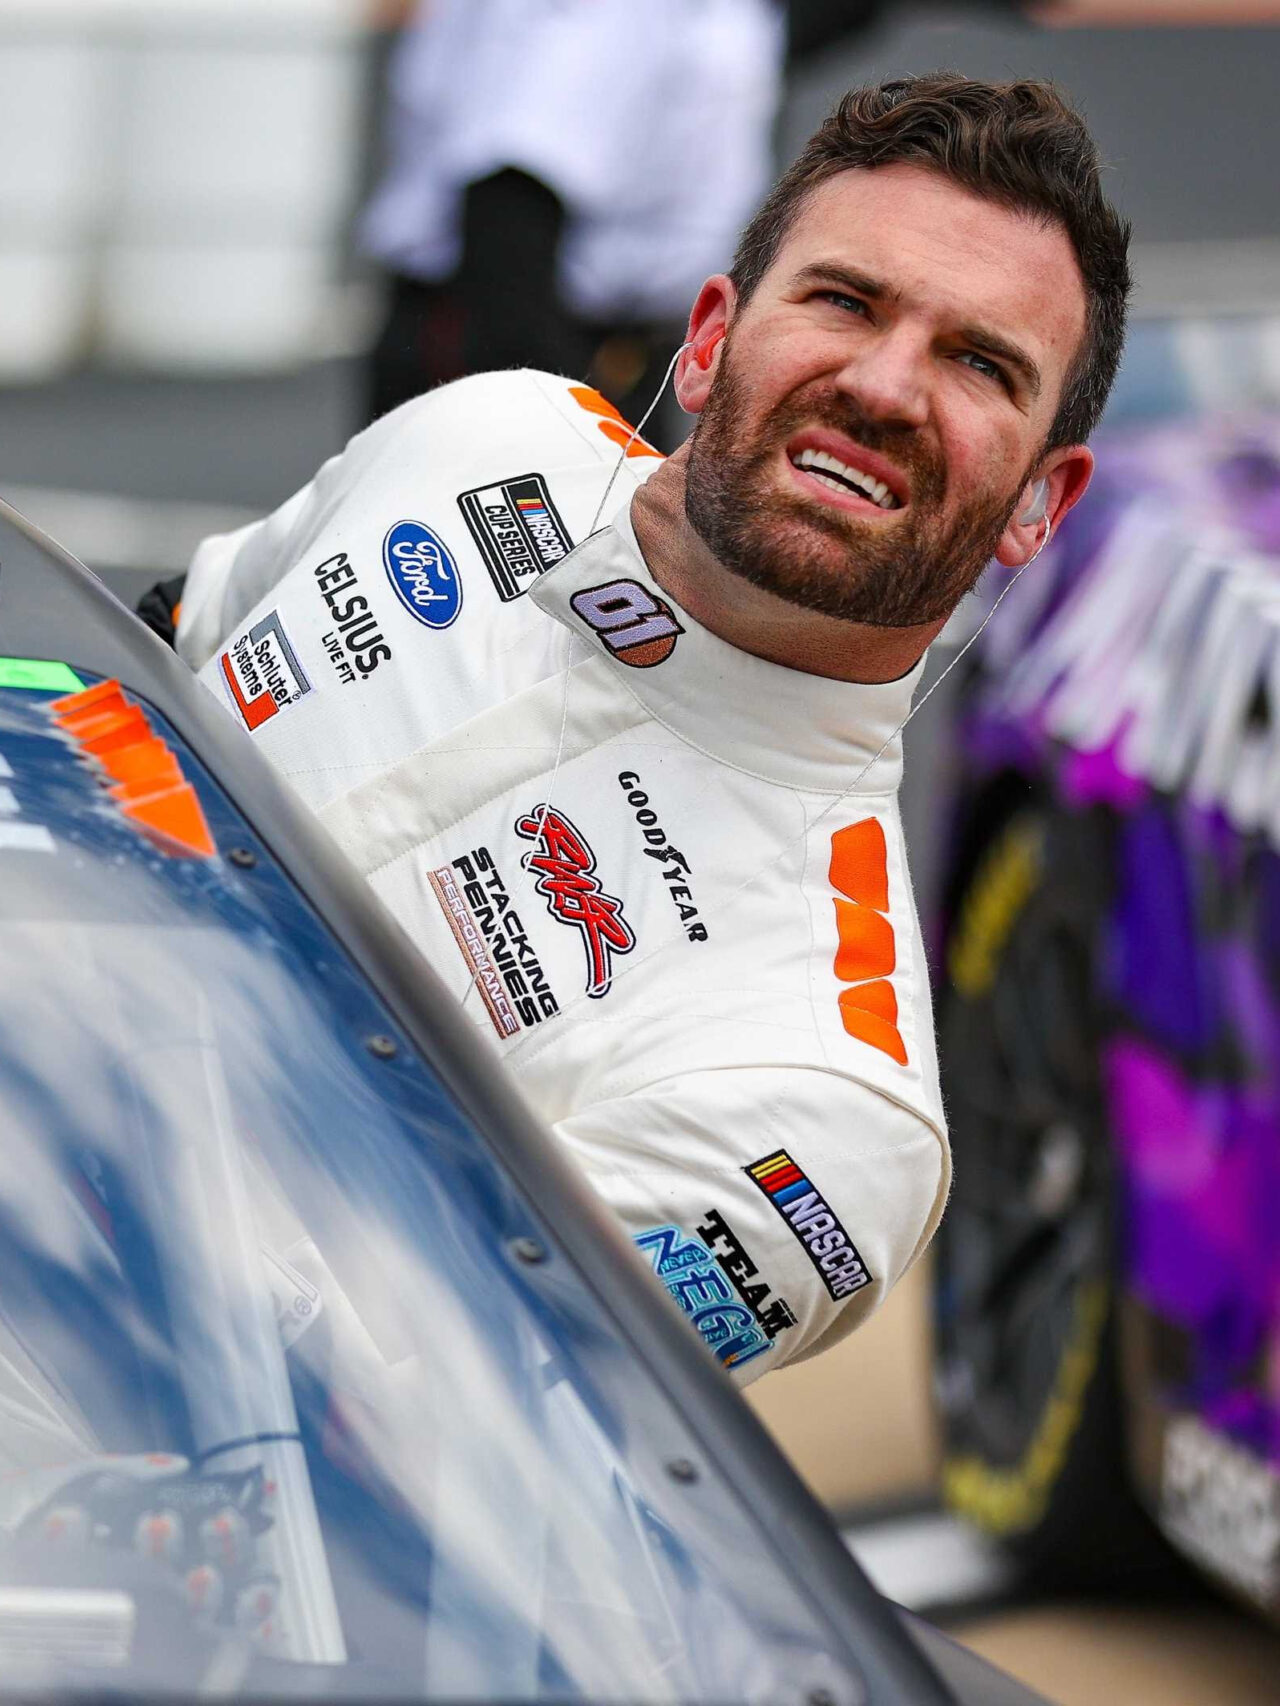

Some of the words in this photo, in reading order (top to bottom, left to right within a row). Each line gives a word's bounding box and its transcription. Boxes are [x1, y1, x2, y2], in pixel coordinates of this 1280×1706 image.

[484, 505, 516, 529] CUP
[523, 512, 566, 563] NASCAR
[392, 541, 450, 606] Ford
[497, 530, 536, 577] SERIES
[570, 578, 686, 653] 01
[231, 634, 263, 696] Systems
[254, 639, 294, 707] Schluter
[322, 631, 345, 663] LIVE
[335, 661, 356, 684] FIT
[618, 771, 709, 943] GOODYEAR
[436, 869, 517, 1033] PERFORMANCE
[451, 855, 541, 1027] PENNIES
[472, 846, 561, 1019] STACKING
[660, 1249, 706, 1273] NEVER
[696, 1209, 795, 1340] TEAM
[781, 1190, 868, 1298] NASCAR
